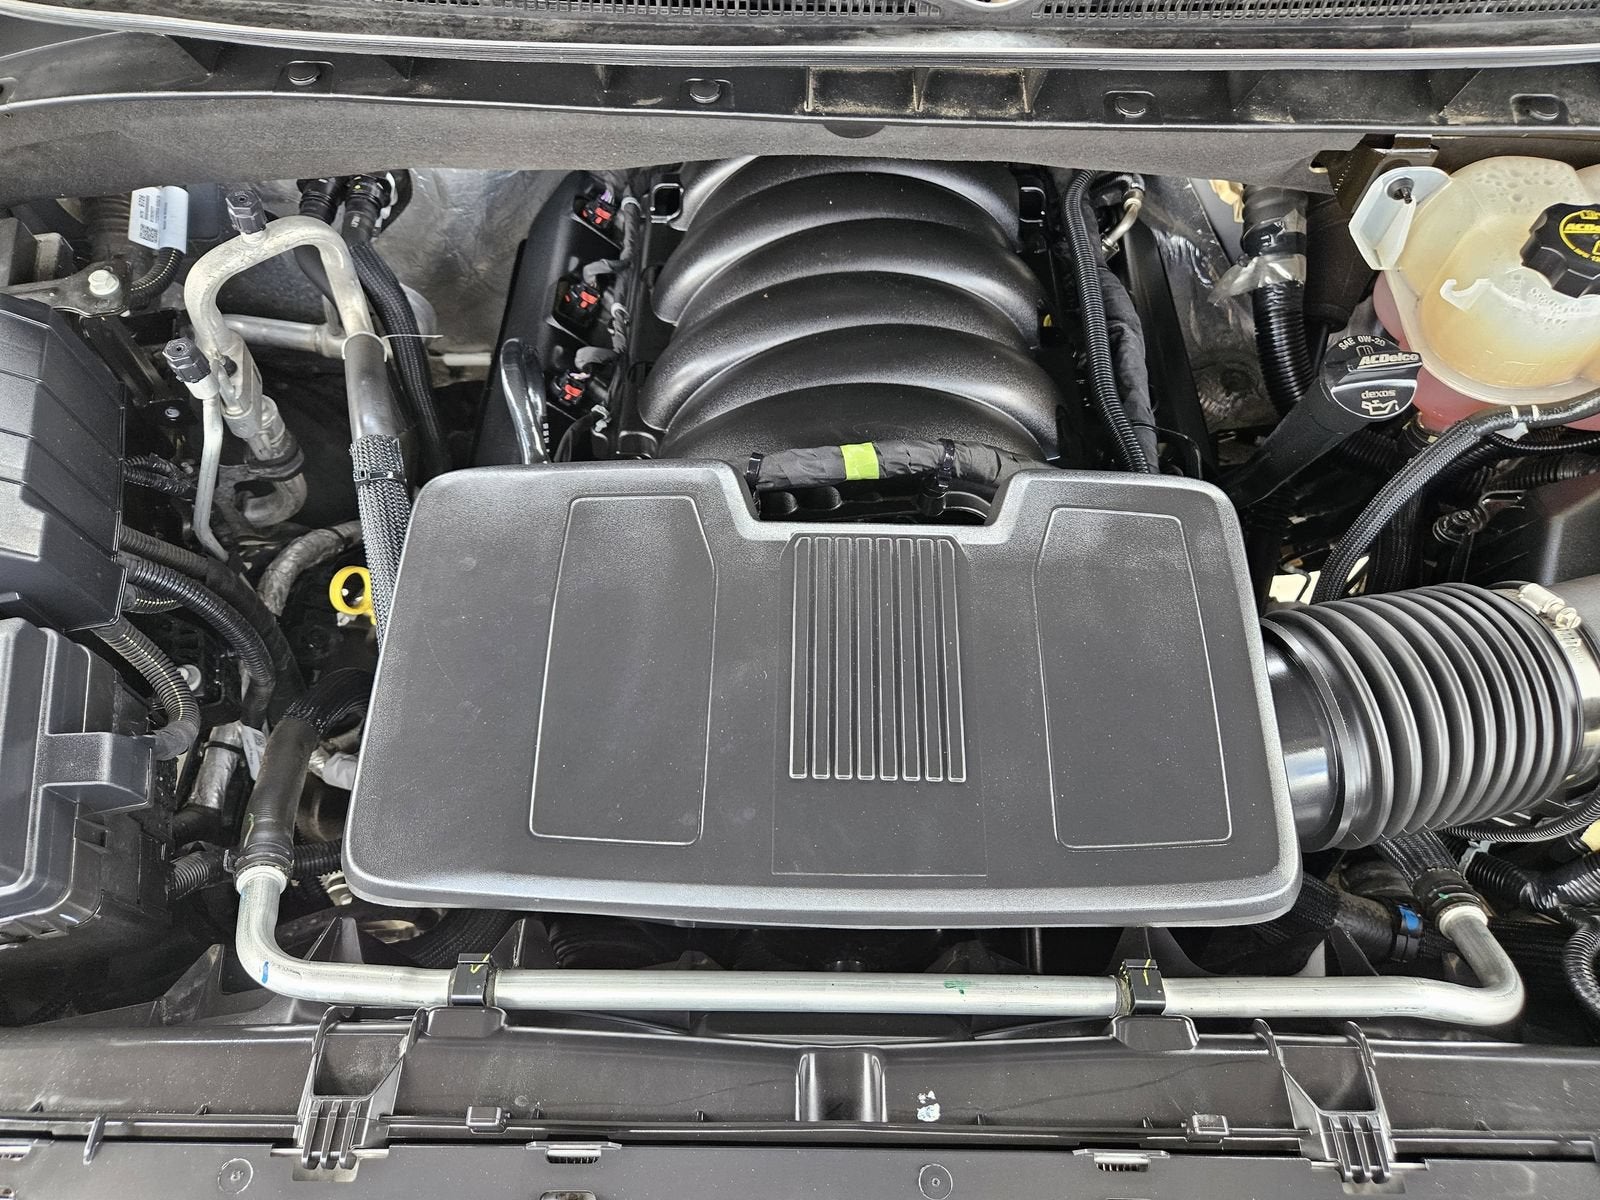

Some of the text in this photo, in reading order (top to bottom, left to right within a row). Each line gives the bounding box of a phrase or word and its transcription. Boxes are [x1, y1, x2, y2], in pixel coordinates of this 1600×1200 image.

[1338, 335, 1386, 350] SAE 0W-20
[1358, 353, 1420, 366] ACDelco
[1361, 389, 1397, 400] dexos
